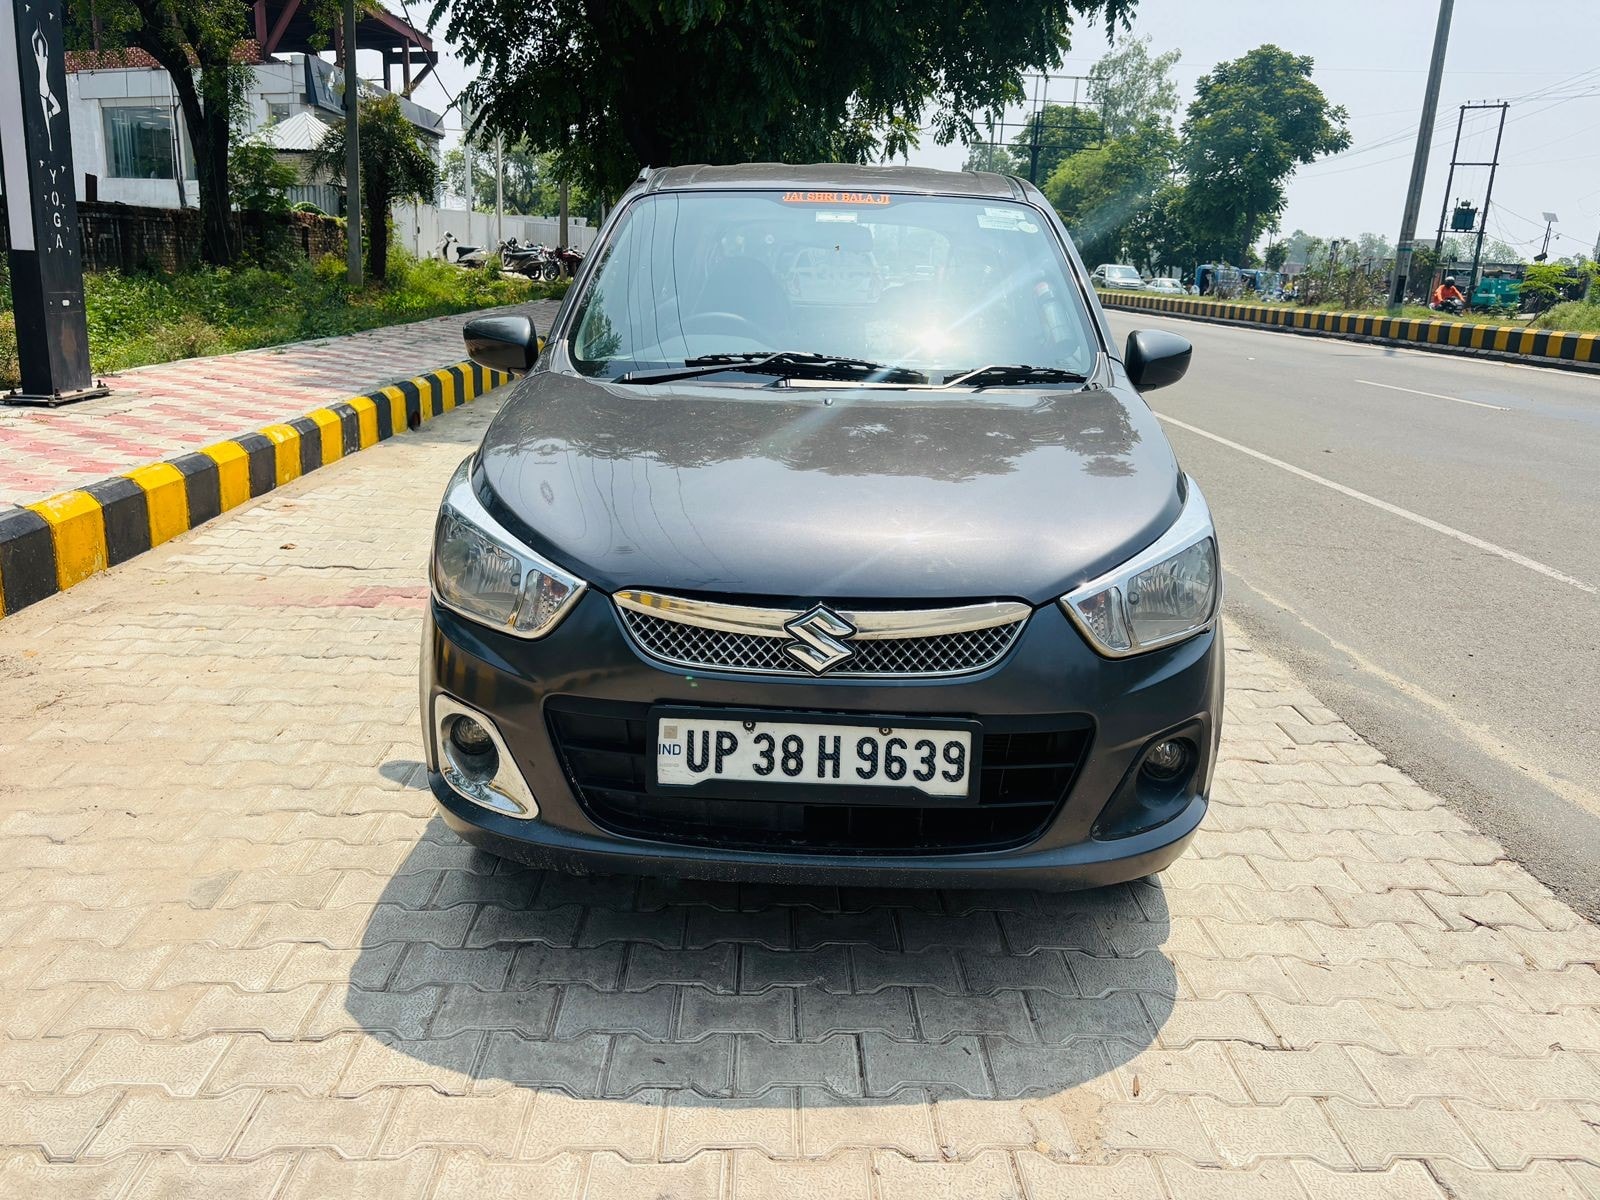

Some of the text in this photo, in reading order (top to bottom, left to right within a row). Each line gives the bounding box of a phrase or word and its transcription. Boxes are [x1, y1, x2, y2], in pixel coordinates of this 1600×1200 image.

[49, 168, 64, 249] YOGA
[782, 192, 803, 202] JAI
[806, 192, 838, 203] SHRI
[658, 743, 682, 756] IND
[686, 729, 966, 783] UP 38 H 9639
